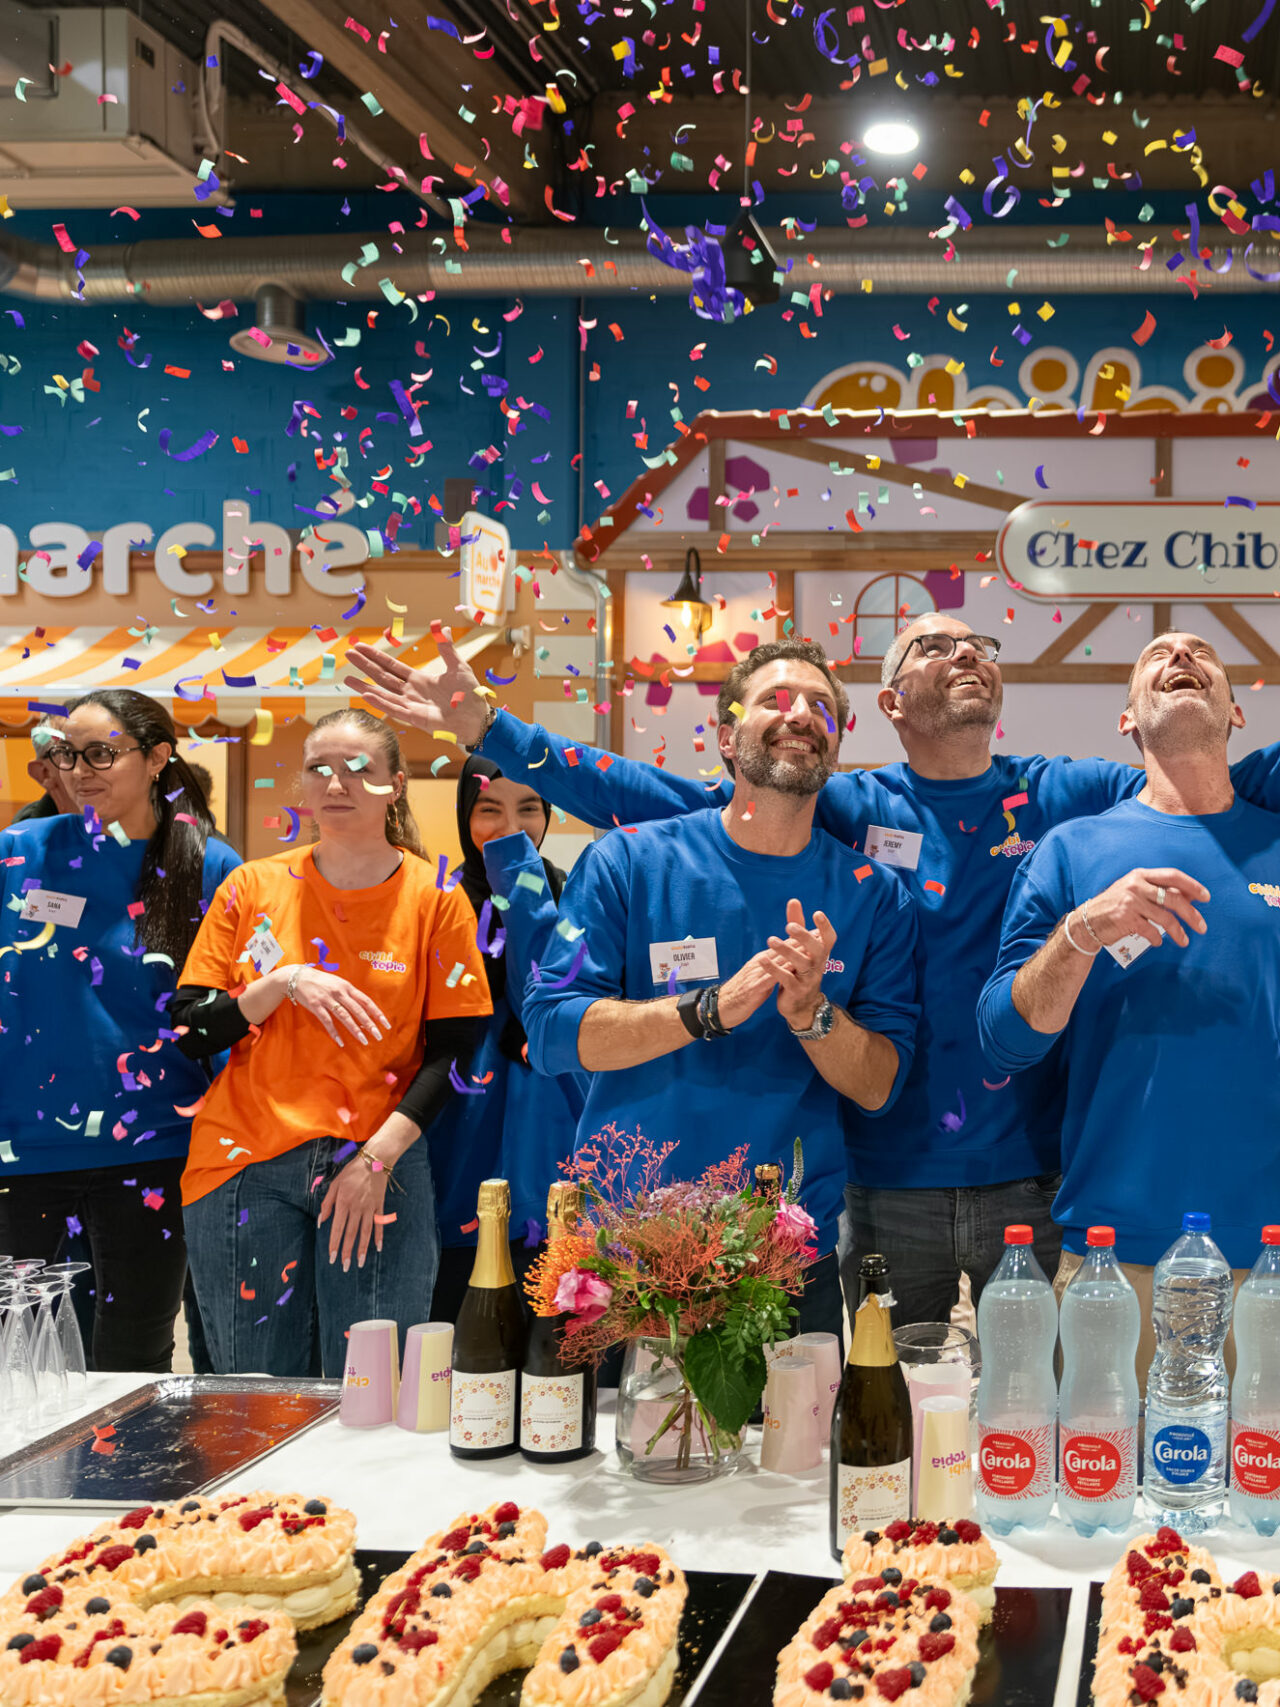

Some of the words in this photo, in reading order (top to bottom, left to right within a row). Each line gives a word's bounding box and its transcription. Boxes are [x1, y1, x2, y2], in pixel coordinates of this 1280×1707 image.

[1027, 531, 1148, 568] Chez
[371, 960, 407, 973] topia
[823, 957, 845, 975] pia
[931, 1450, 967, 1469] topia
[982, 1447, 1031, 1470] Carola
[1065, 1450, 1117, 1473] Carola
[1155, 1440, 1208, 1463] Carola
